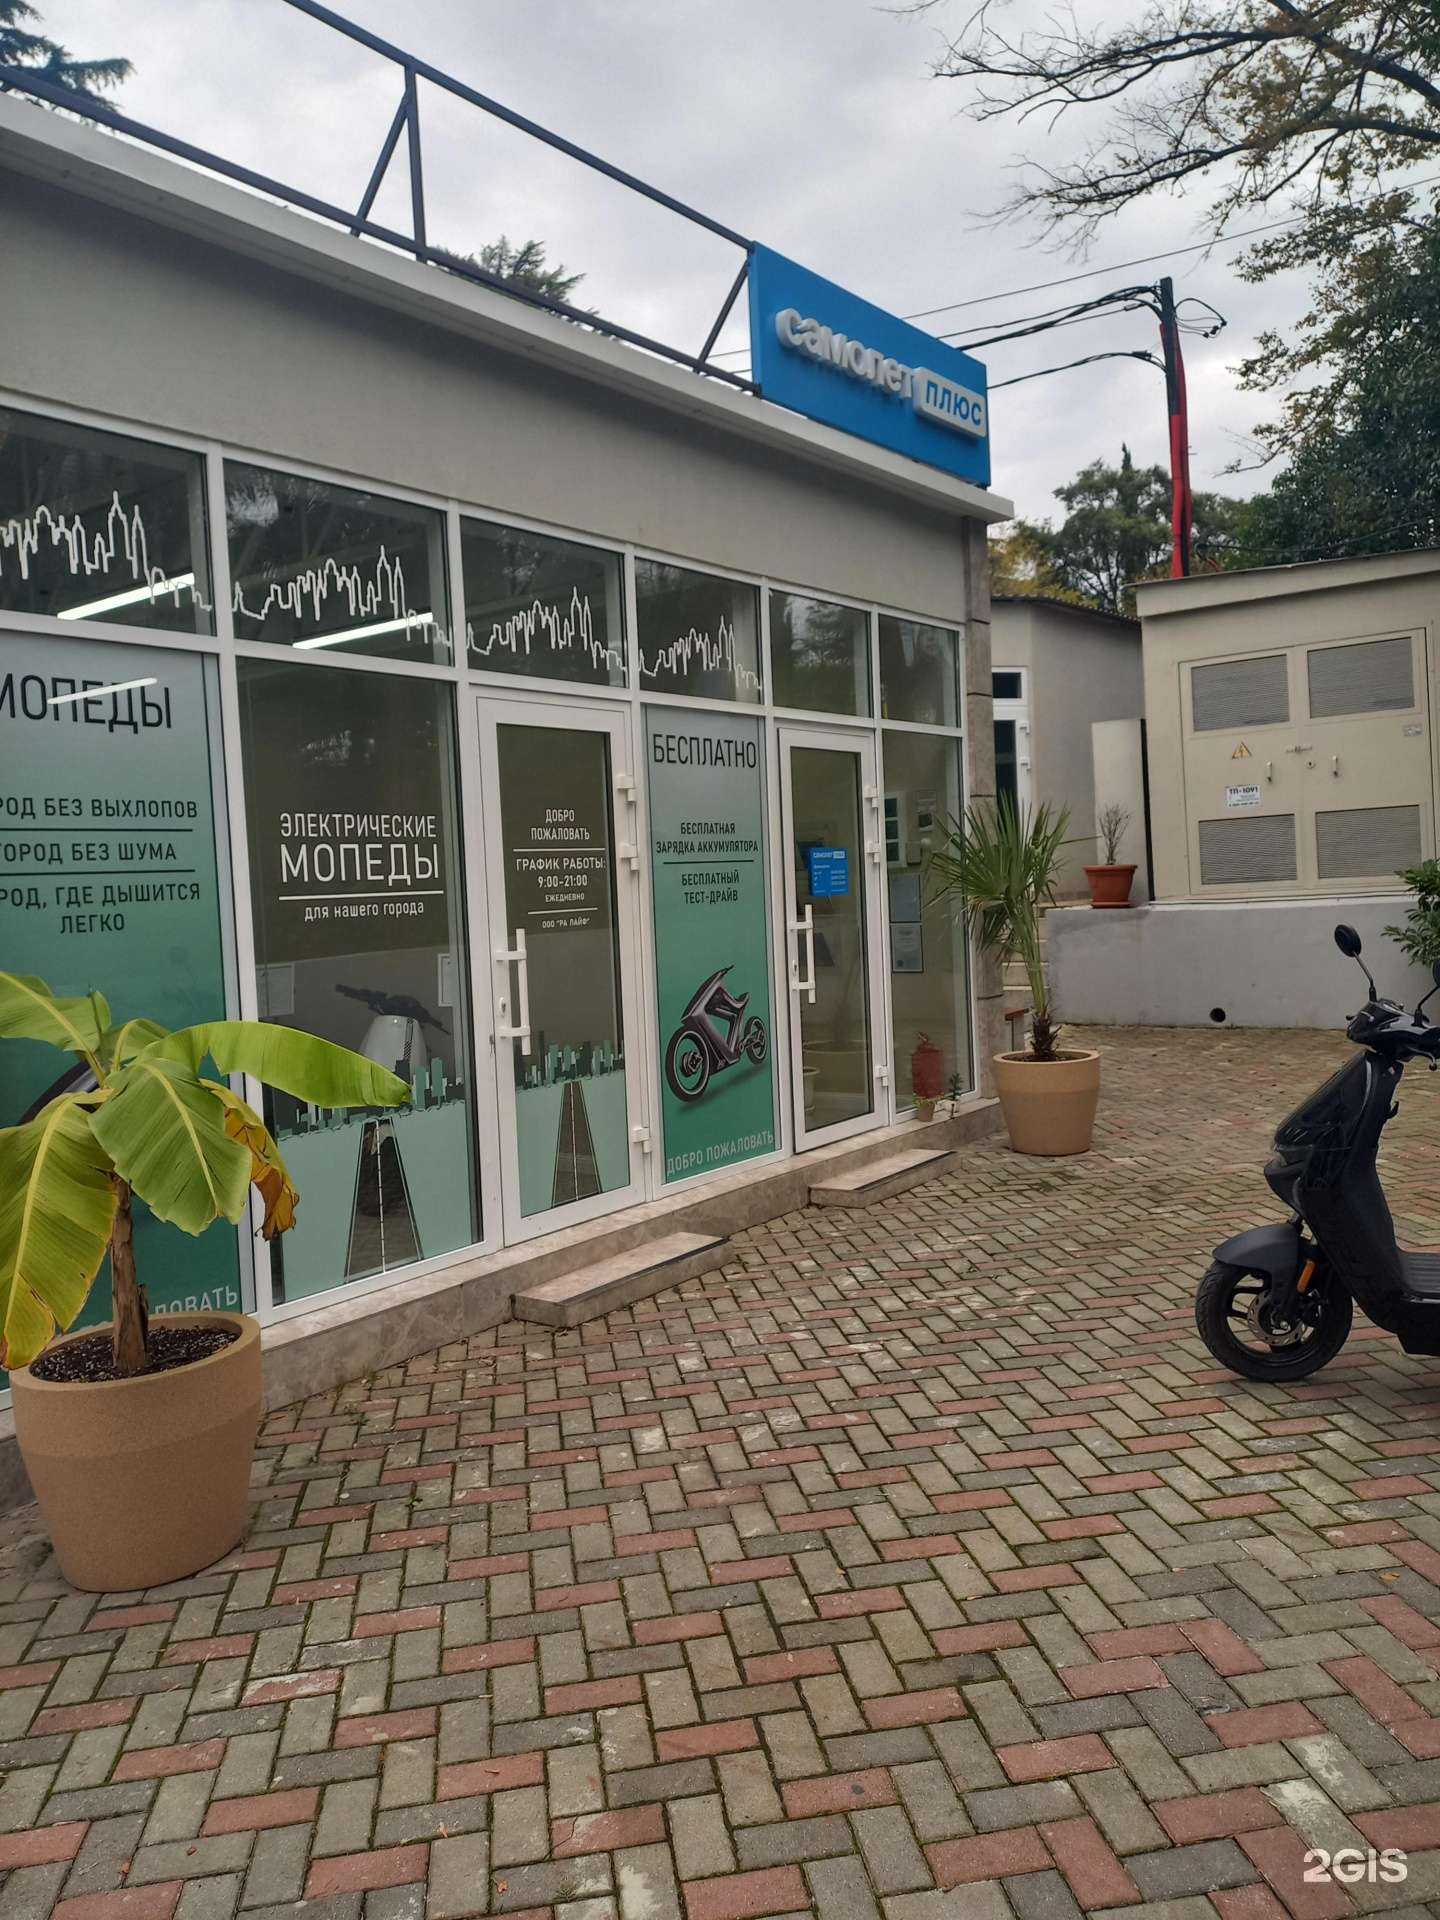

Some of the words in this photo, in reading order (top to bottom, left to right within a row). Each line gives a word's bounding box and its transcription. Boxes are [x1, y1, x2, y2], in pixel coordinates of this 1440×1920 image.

[653, 734, 757, 768] БЕСПЛАТНО
[44, 798, 83, 817] БЕЗ
[91, 799, 198, 818] ВЫХЛОПОВ
[545, 809, 575, 823] ДОБРО
[280, 812, 437, 838] ЭЛЕКТРИЧЕСКИЕ
[530, 827, 590, 840] ПОЖАЛОВАТЬ
[680, 822, 736, 835] БЕСПЛАТНАЯ
[0, 843, 63, 864] ОРОД
[71, 843, 110, 861] БЕЗ
[118, 843, 177, 861] ШУМА
[656, 841, 695, 855] ЗАРЯДКА
[697, 840, 759, 853] АККУМУЛЯТОРА
[280, 843, 439, 887] МОПЕДЫ
[516, 858, 560, 871] ГРАФИК
[681, 869, 740, 887] БЕСПЛАТНЫЙ
[55, 886, 94, 908] ГДЕ
[101, 883, 200, 907] ДЫШИТСЯ
[545, 892, 585, 903] ЕЖЕДНЕВНО
[684, 887, 739, 905] ТЕСТ-ДРАЙВ
[304, 906, 329, 922] для
[334, 904, 379, 918] нашего
[383, 901, 424, 918] города
[60, 913, 125, 934] ЛЕГКО
[666, 1150, 703, 1176] ДОБРО
[706, 1130, 774, 1162] ПОЖАЛОВАТЬ
